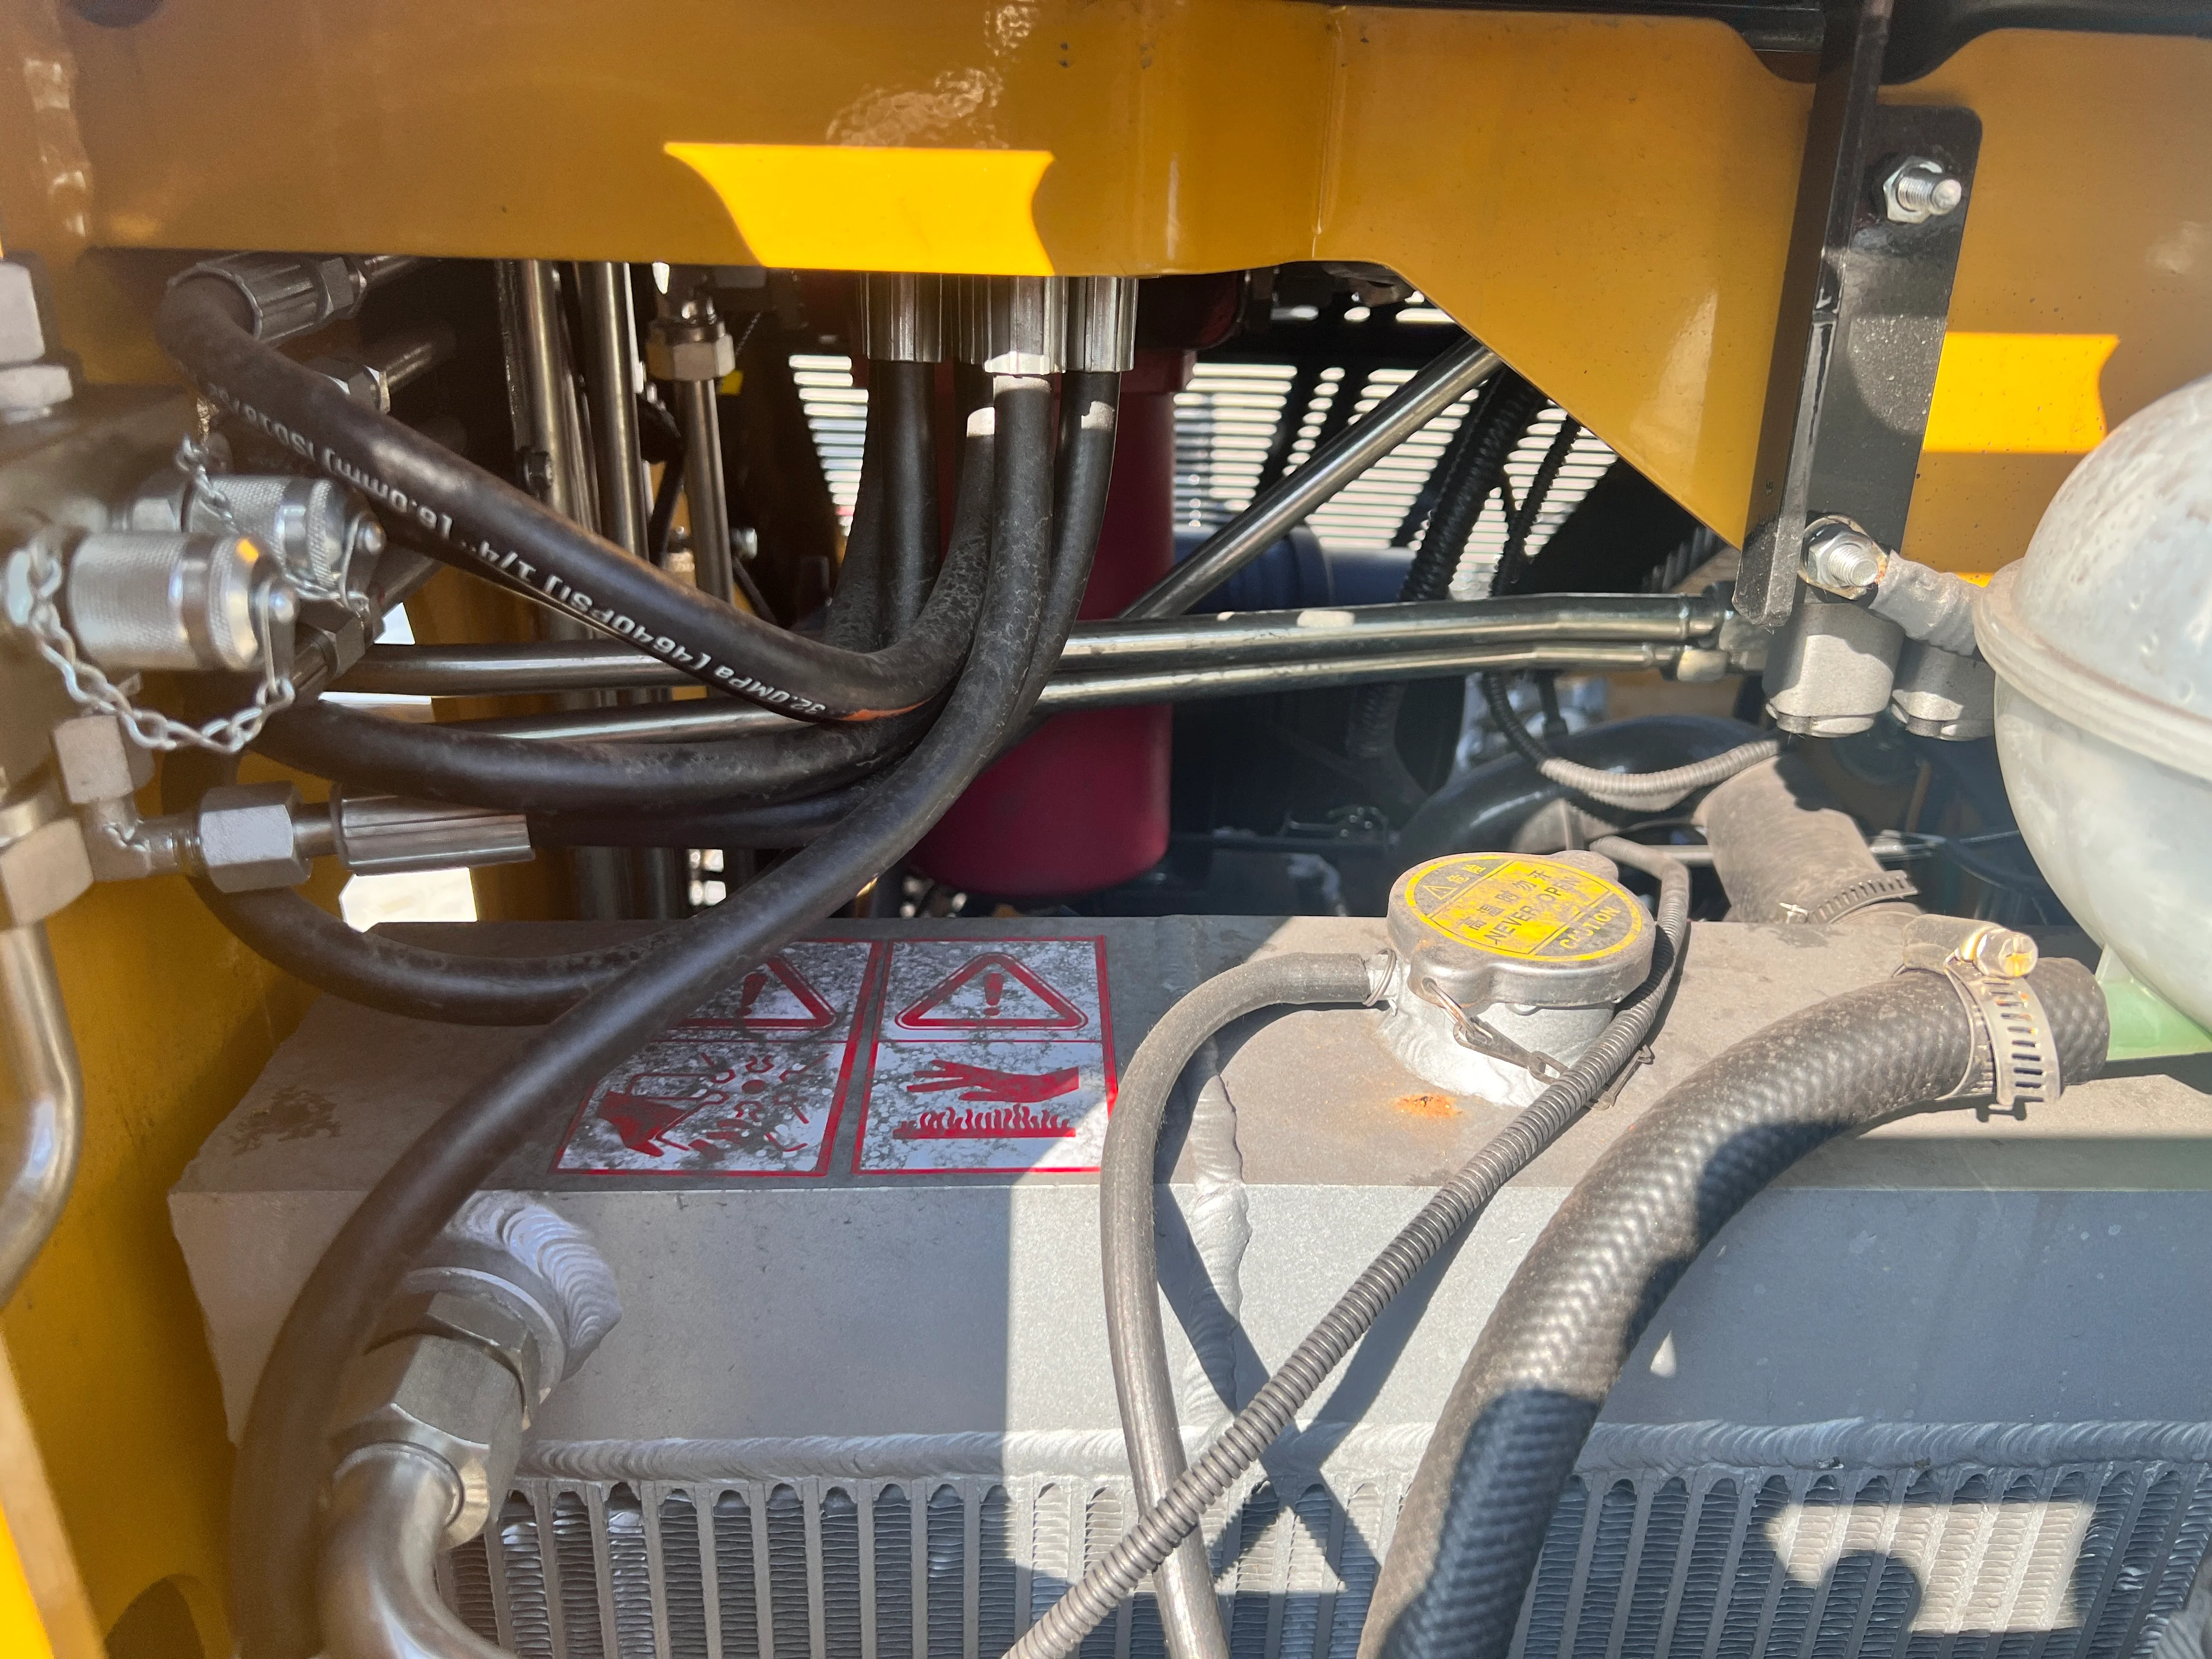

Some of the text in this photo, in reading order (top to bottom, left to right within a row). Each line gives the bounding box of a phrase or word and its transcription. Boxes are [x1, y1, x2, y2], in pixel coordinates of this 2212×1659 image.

[714, 665, 826, 714] 32.0MPa
[1483, 876, 1581, 943] NEVER OPEN
